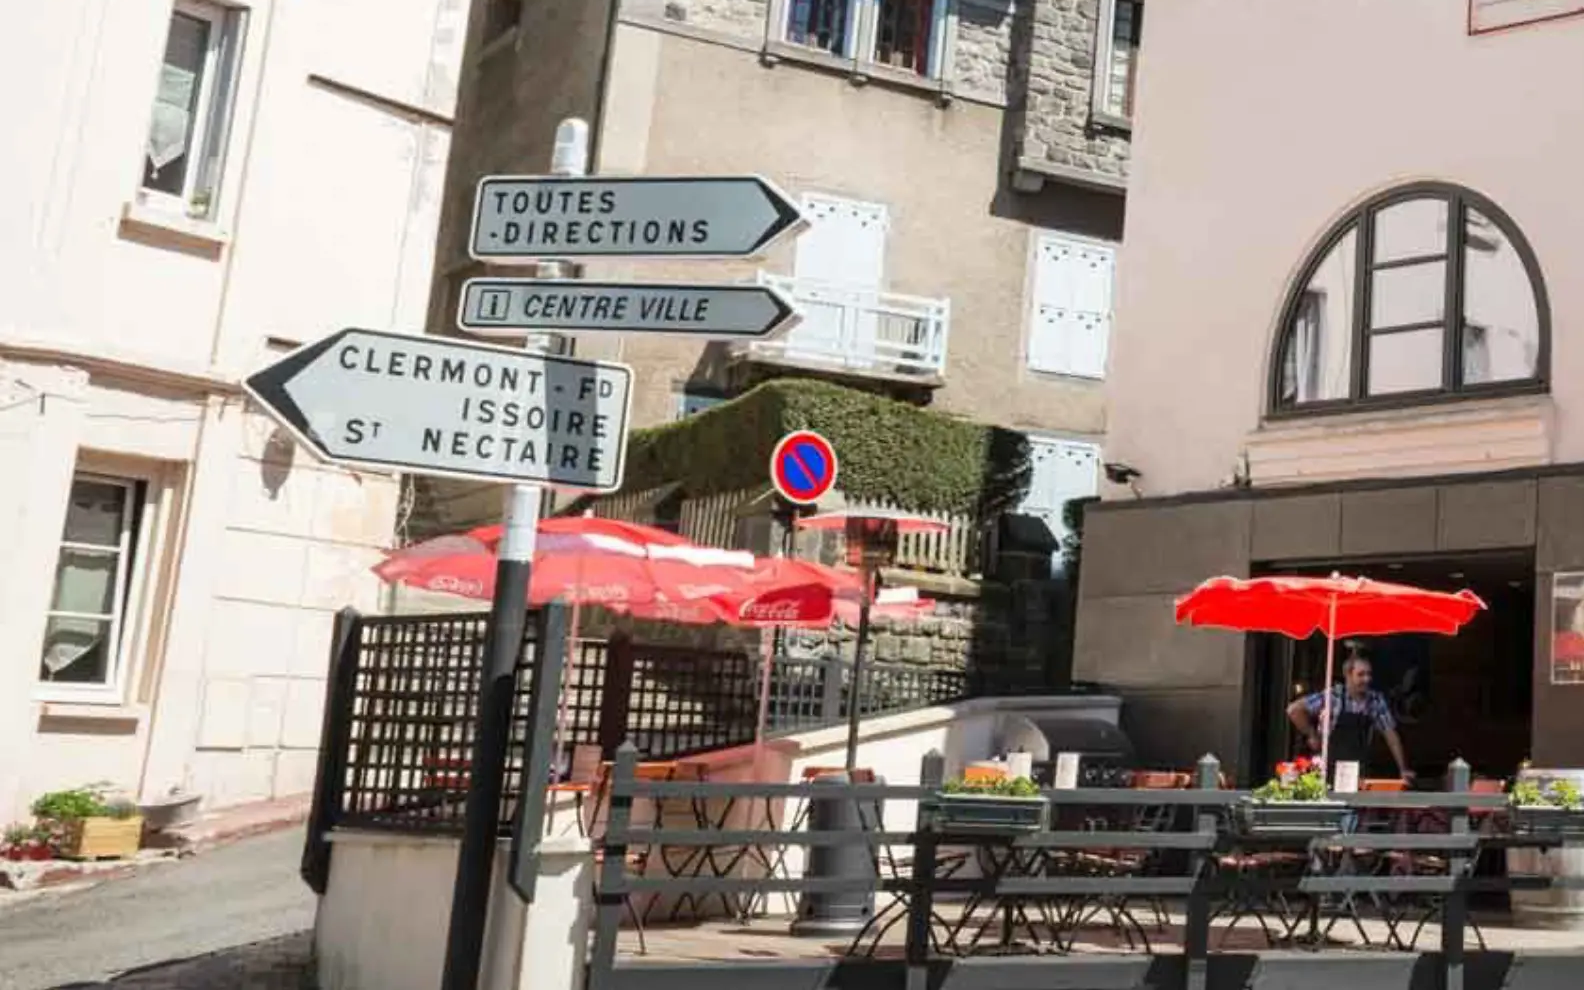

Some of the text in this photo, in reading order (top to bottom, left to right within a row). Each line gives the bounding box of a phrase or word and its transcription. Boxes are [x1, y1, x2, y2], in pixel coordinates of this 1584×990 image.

[494, 191, 616, 214] TOUTES
[523, 294, 629, 319] CENTRE
[640, 296, 710, 322] VILLE
[461, 397, 609, 438] ISSOIRE
[422, 427, 605, 471] NECTAIRE
